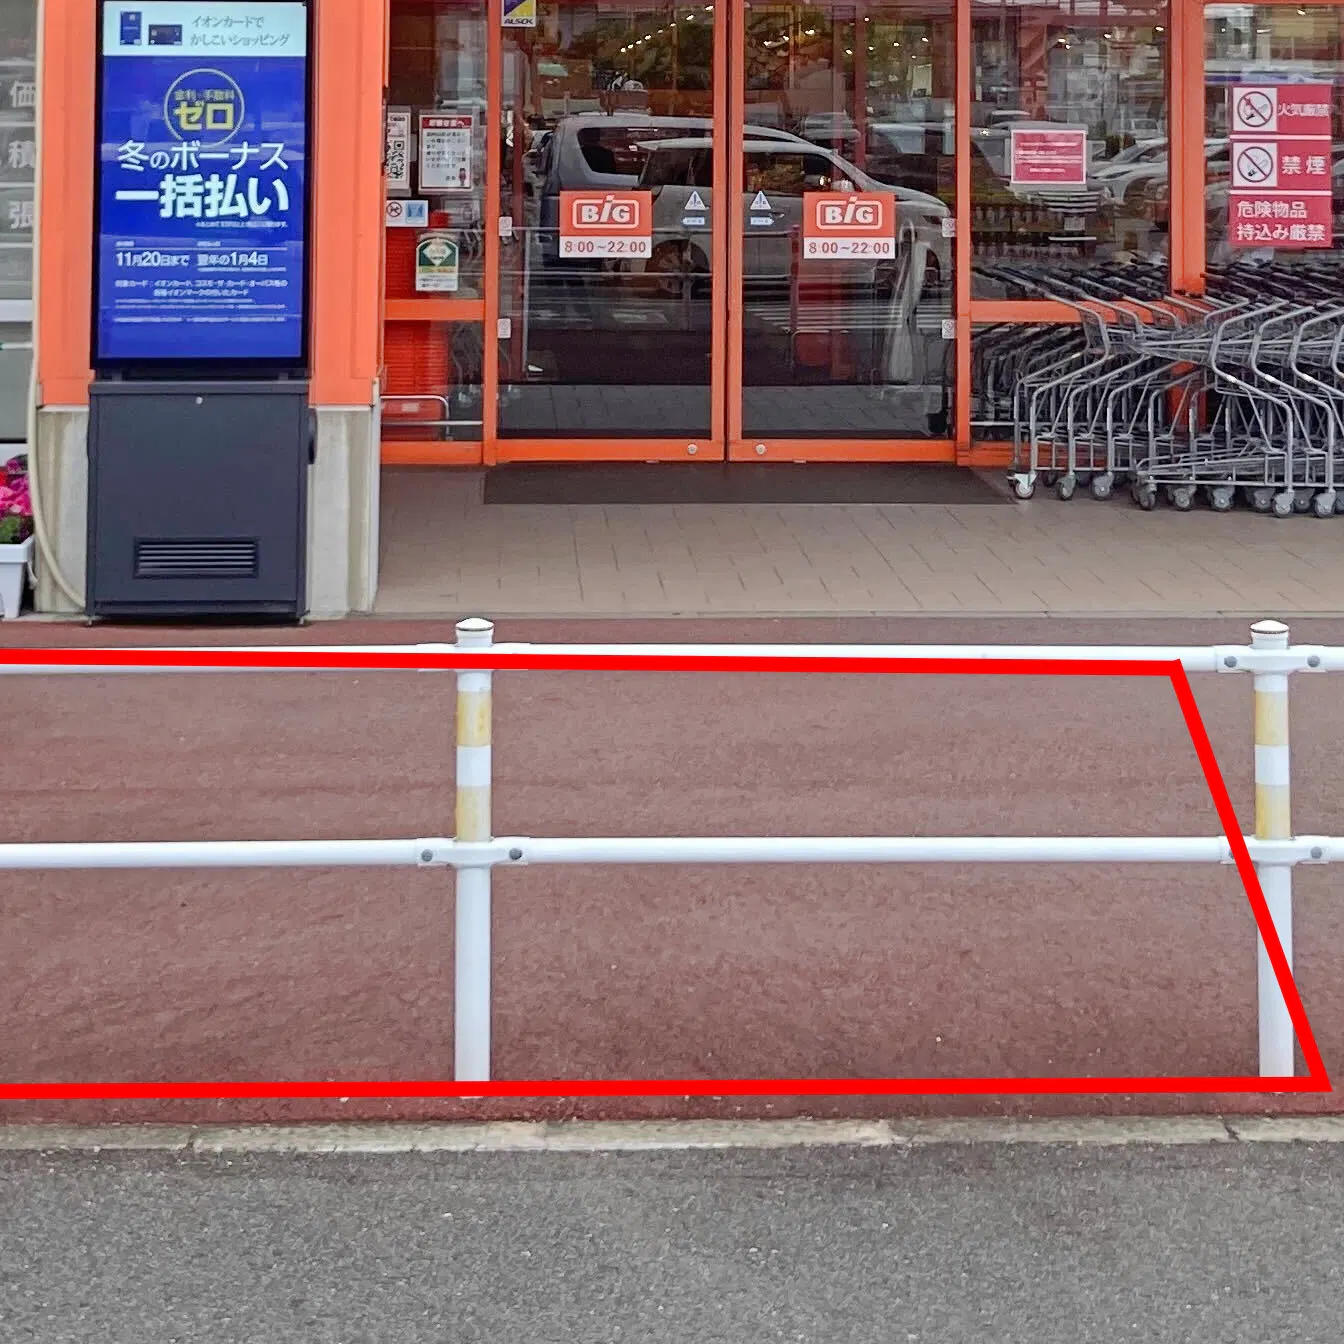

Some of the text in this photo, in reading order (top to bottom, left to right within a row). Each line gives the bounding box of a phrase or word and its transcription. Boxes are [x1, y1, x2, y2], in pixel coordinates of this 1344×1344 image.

[172, 101, 234, 131] ゼロ
[117, 139, 289, 172] 冬のボーナス
[1281, 156, 1326, 175] 禁煙
[115, 173, 289, 218] 一括払い
[1237, 201, 1307, 218] 危険物品
